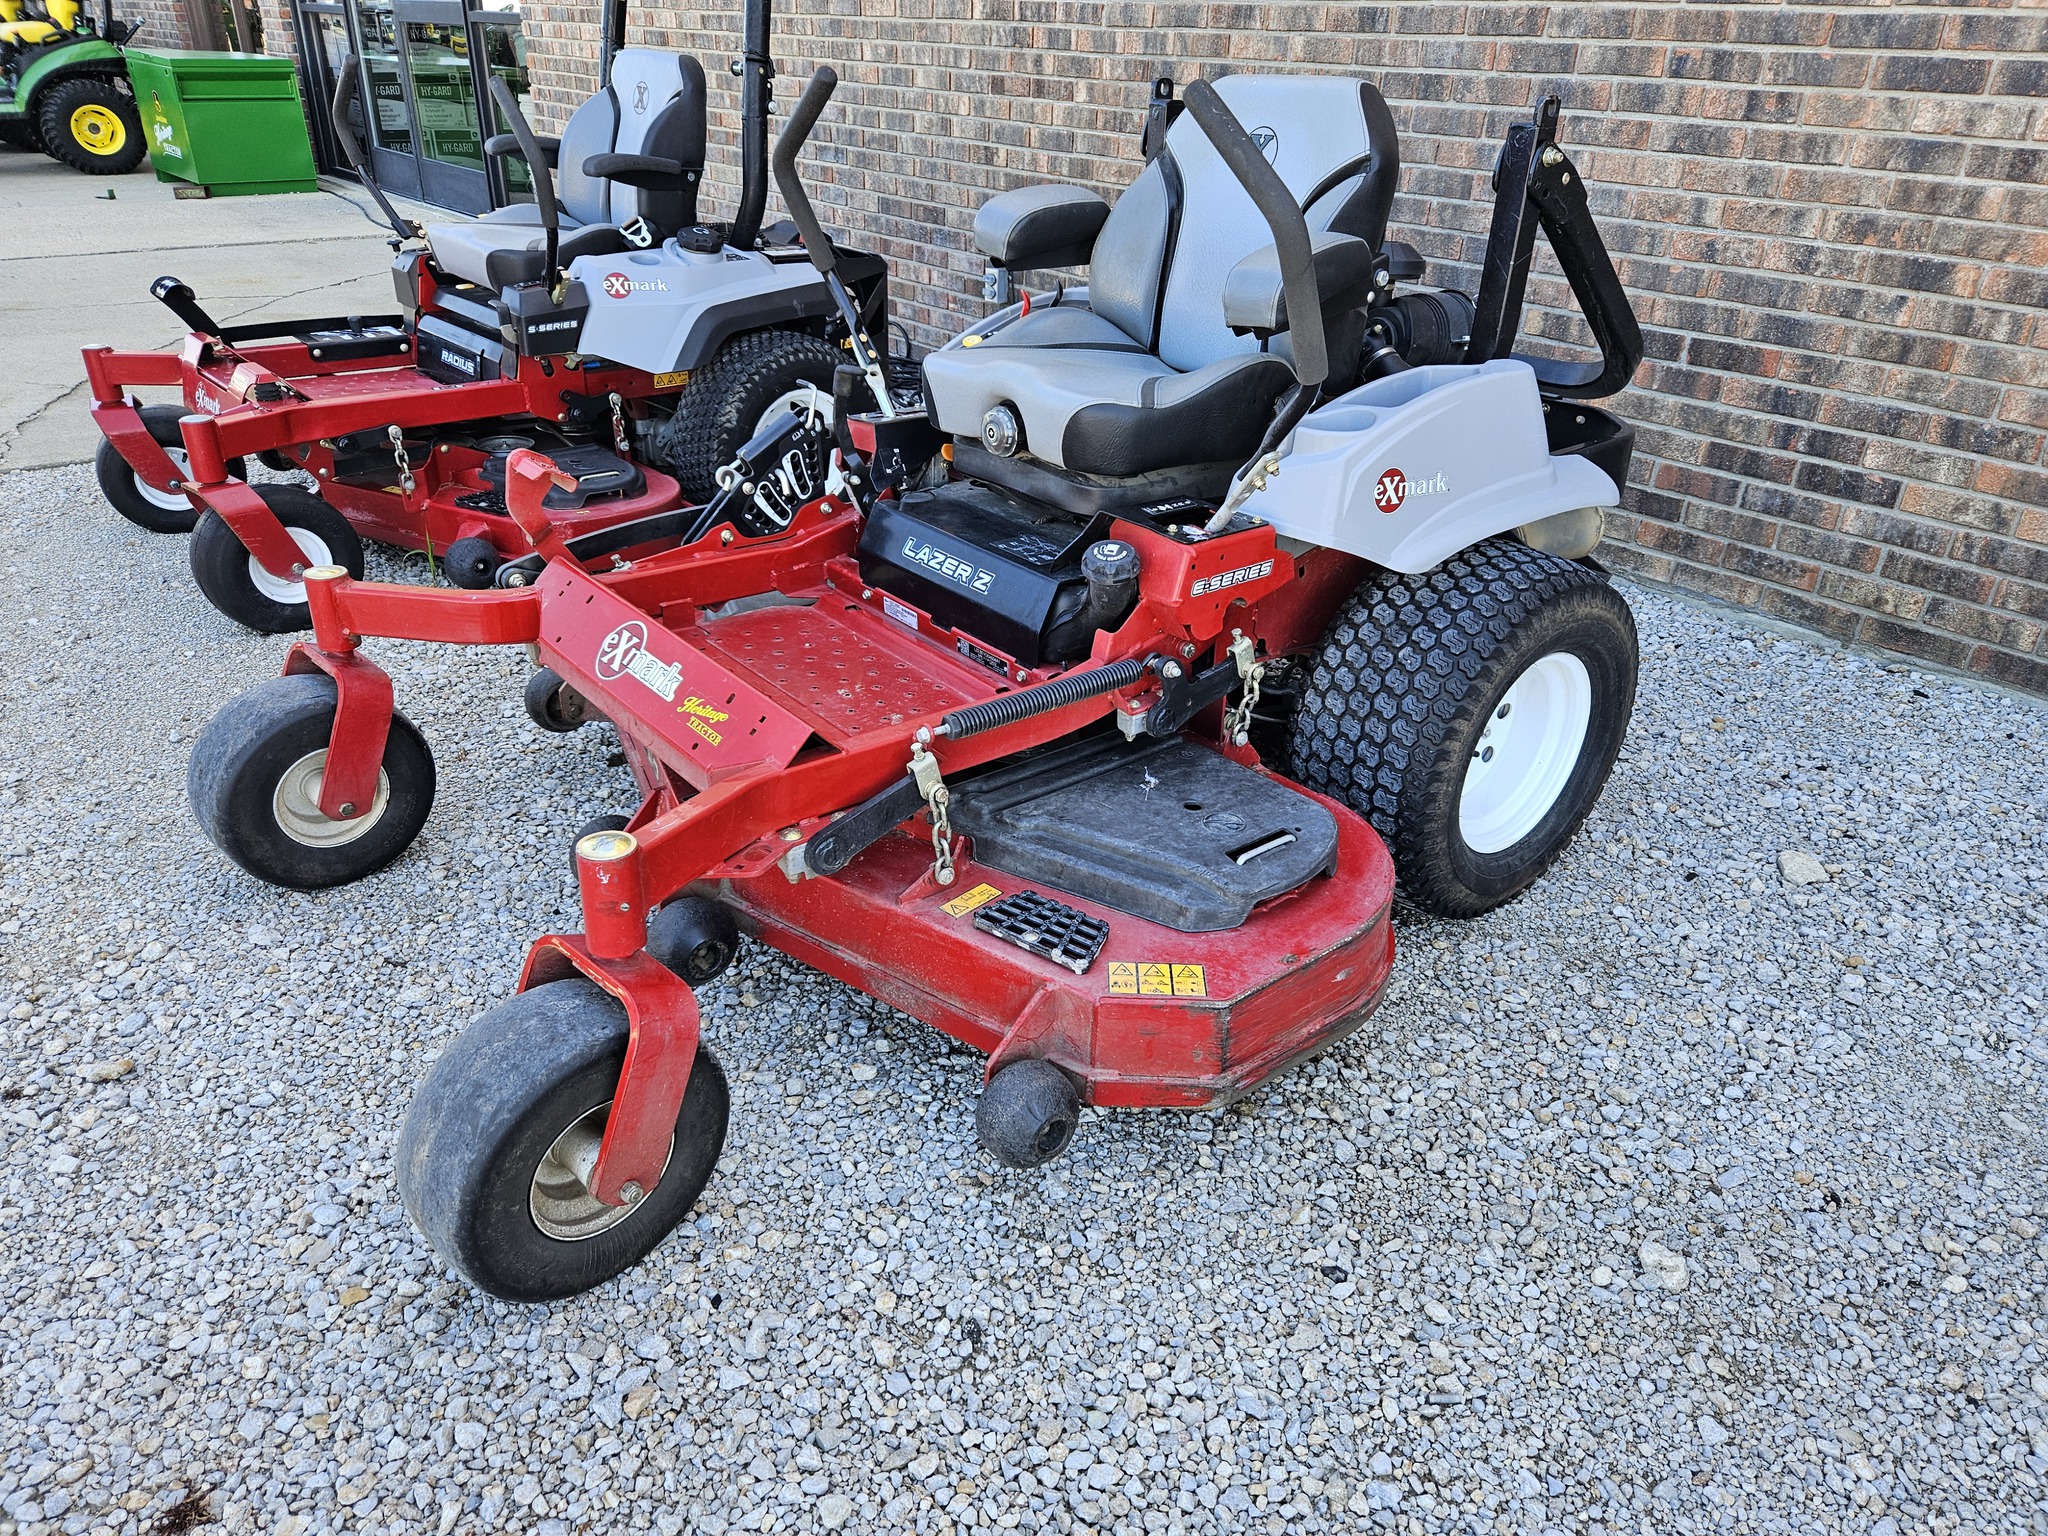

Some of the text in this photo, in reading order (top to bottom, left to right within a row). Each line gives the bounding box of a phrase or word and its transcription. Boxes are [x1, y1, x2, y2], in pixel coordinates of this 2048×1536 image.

[421, 86, 452, 96] HY-GARD
[443, 143, 474, 153] HY-GARD
[441, 349, 475, 375] RADIUS
[901, 536, 974, 586] LAZER
[969, 567, 996, 595] Z
[1191, 559, 1274, 597] E-SERIES
[600, 629, 683, 698] eXmark
[677, 696, 730, 723] Heritage
[688, 716, 723, 746] TRACTOR
